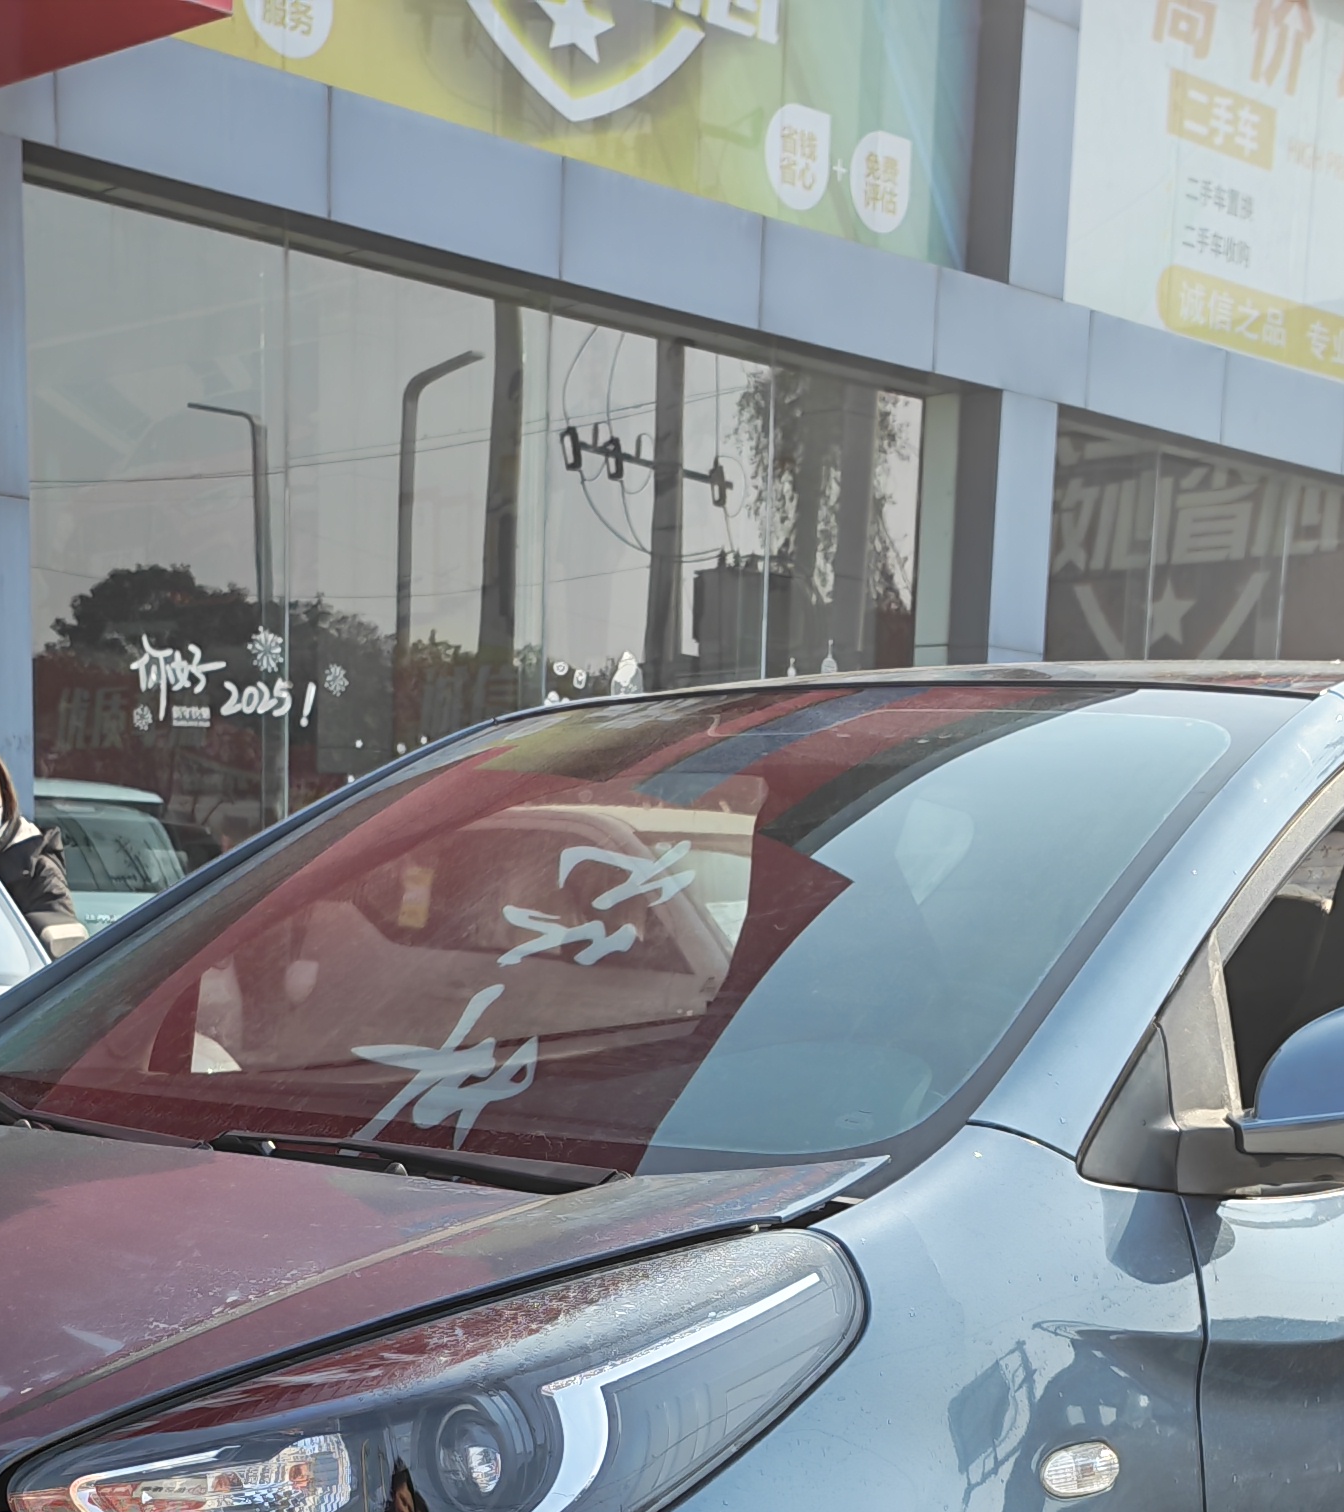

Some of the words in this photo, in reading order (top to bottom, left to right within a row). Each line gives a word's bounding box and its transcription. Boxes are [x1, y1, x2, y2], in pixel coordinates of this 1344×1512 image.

[1183, 88, 1261, 156] 二手车
[1179, 279, 1287, 348] 诚信之品
[130, 634, 226, 721] 你好
